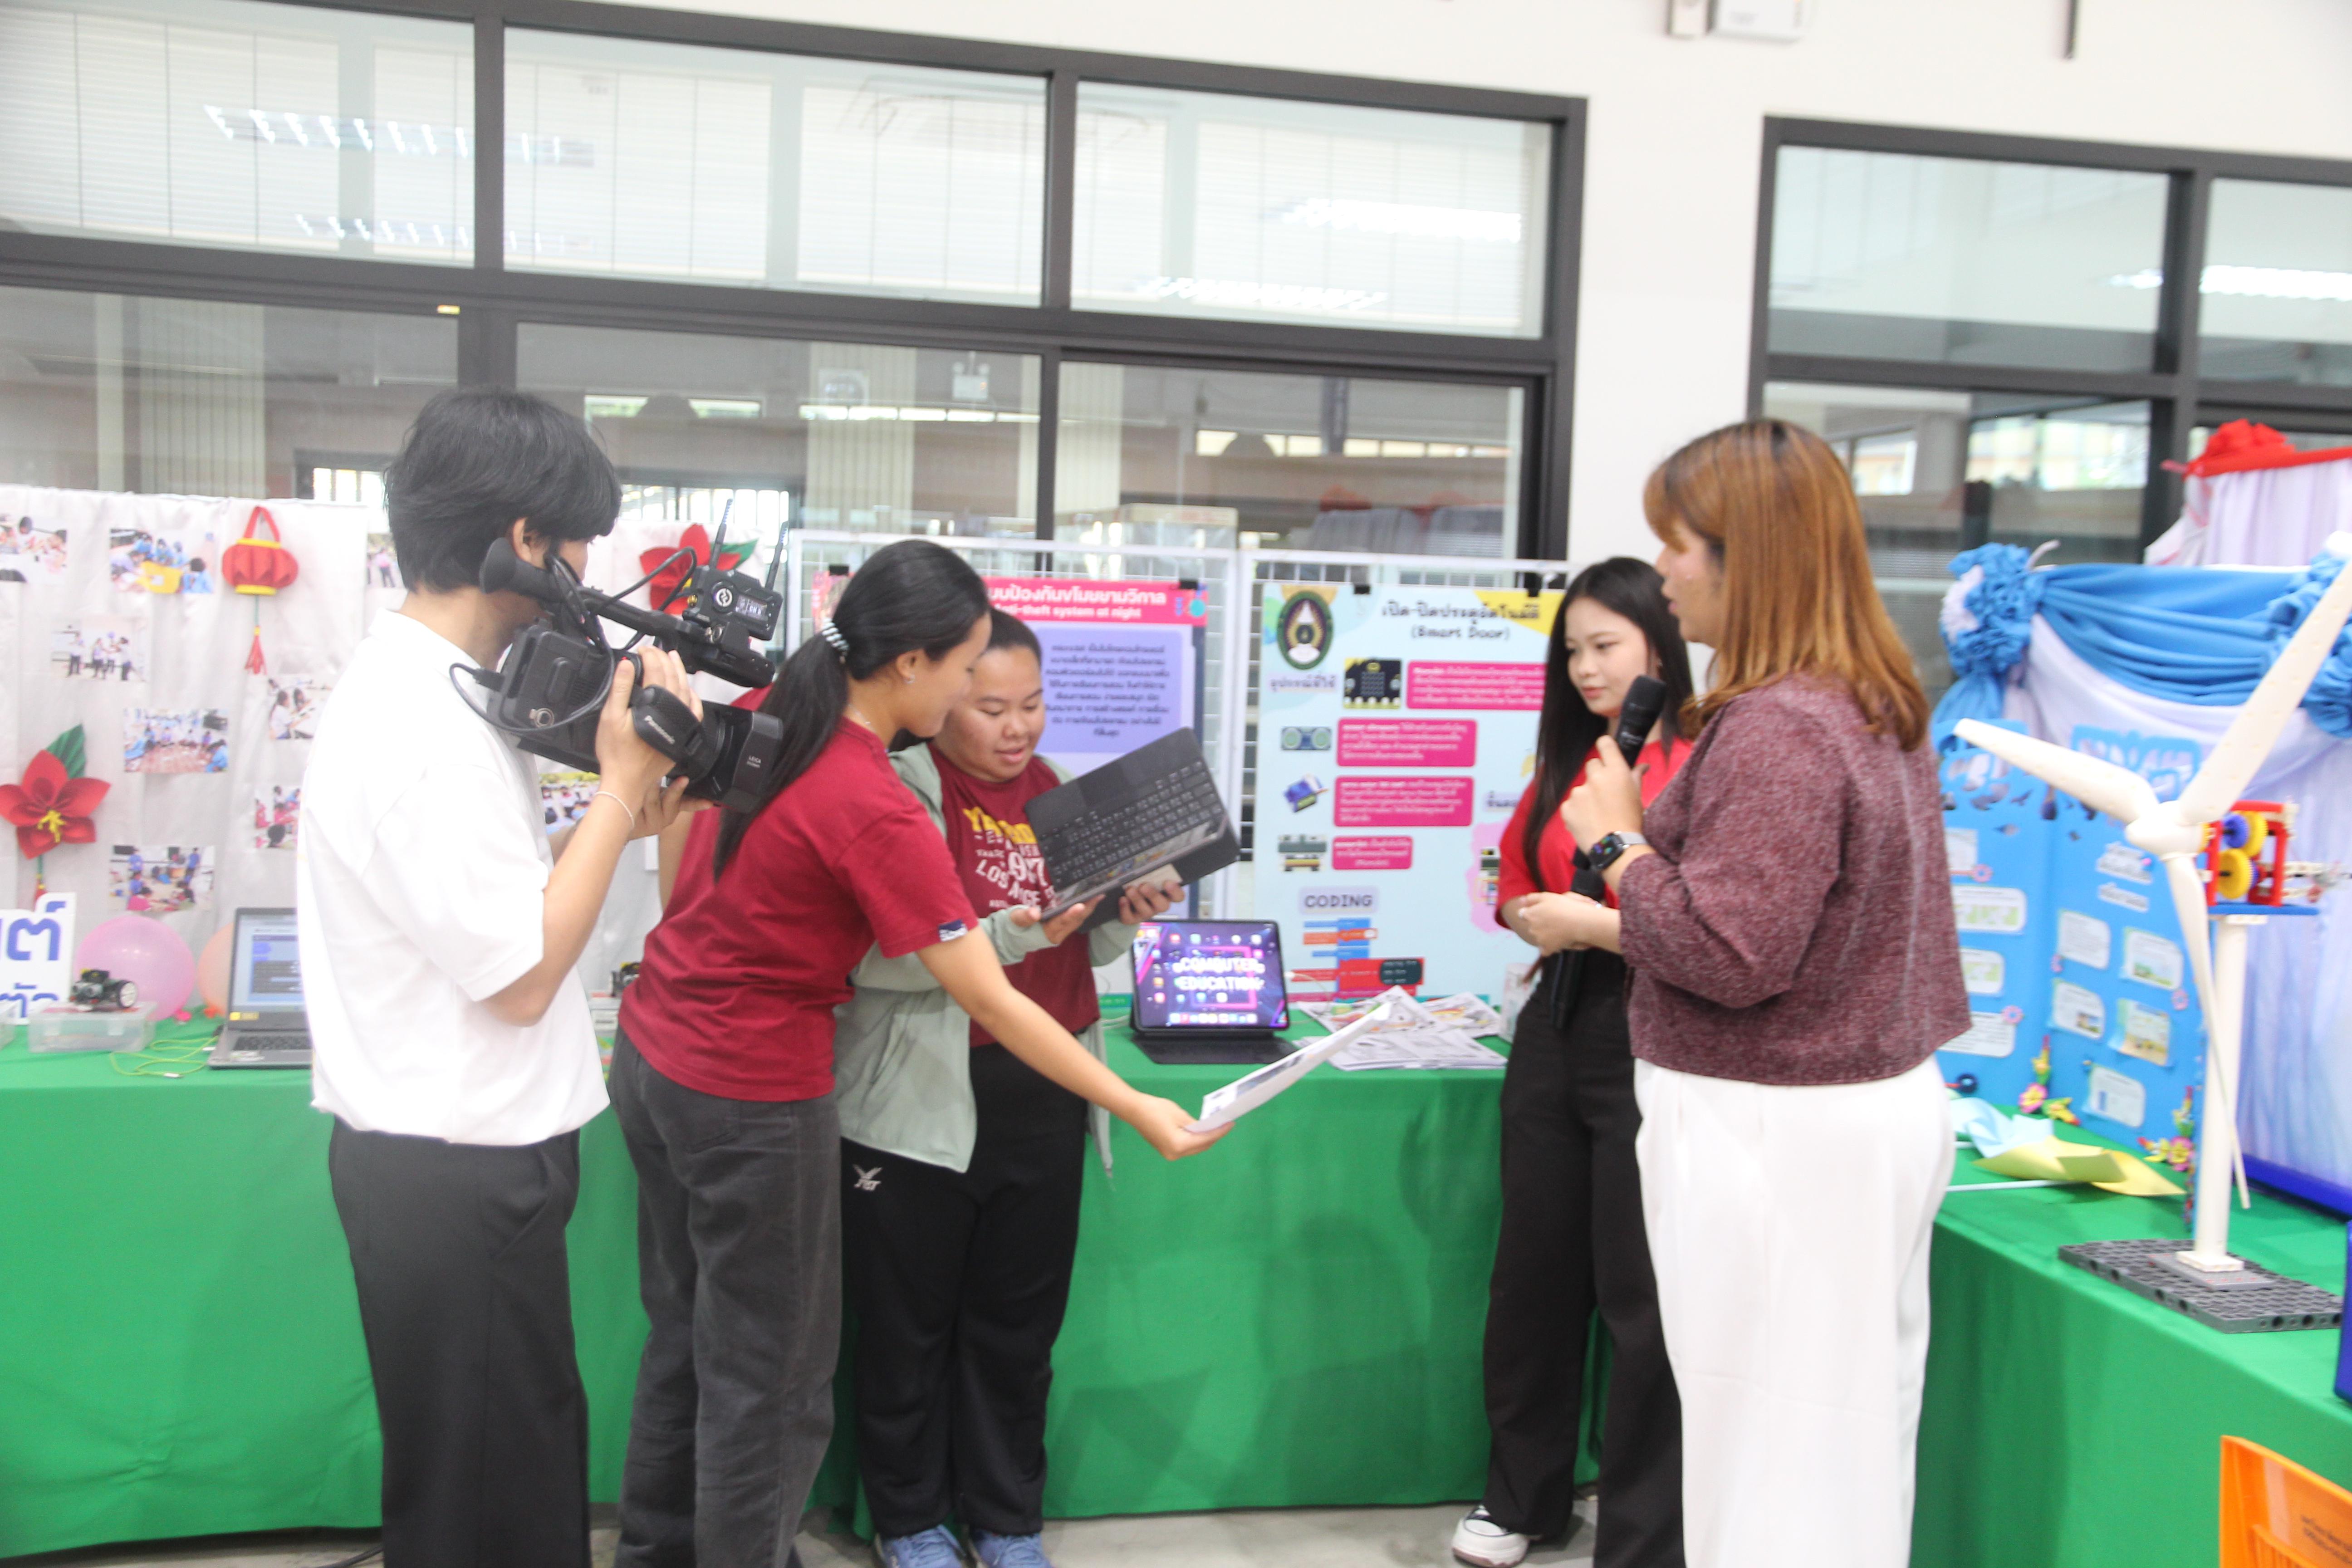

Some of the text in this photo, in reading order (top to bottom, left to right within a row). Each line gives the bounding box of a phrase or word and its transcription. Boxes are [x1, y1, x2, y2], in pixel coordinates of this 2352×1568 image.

[1053, 607, 1095, 618] system
[1096, 608, 1109, 617] at
[1111, 606, 1142, 620] night
[1468, 626, 1511, 641] Door)
[644, 715, 676, 745] Panasonic
[1305, 894, 1373, 907] CODING
[1179, 957, 1260, 972] COMPUTER
[1179, 976, 1261, 991] EDUCATION
